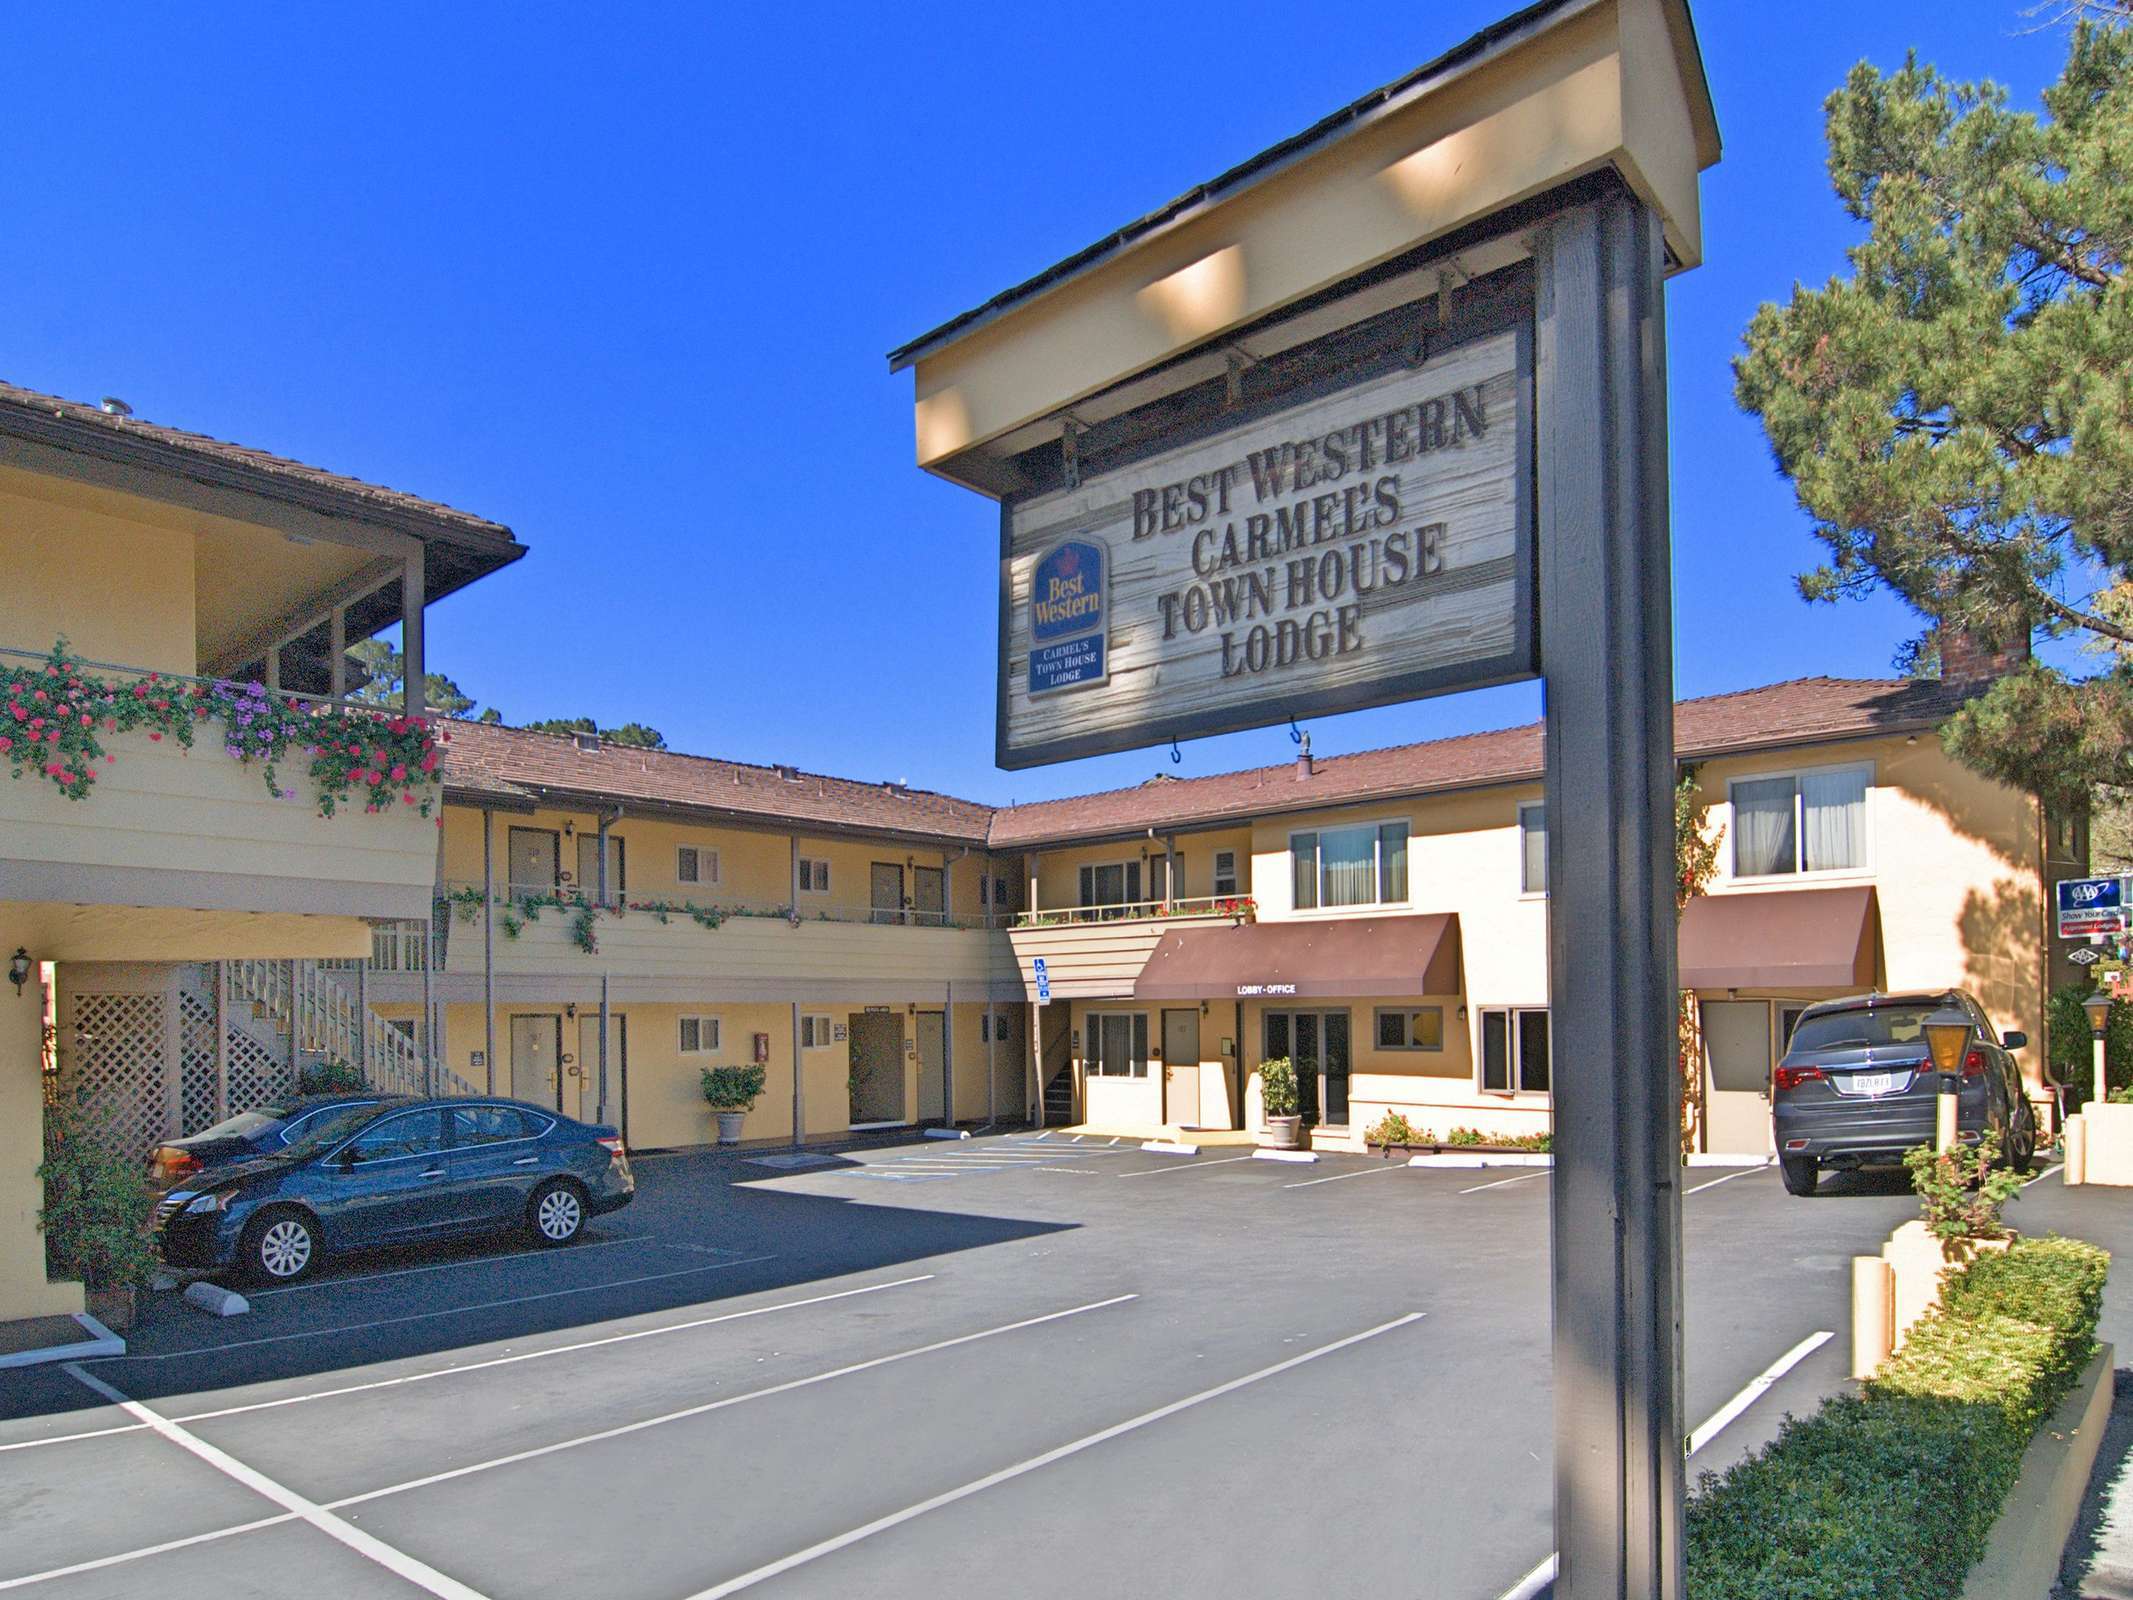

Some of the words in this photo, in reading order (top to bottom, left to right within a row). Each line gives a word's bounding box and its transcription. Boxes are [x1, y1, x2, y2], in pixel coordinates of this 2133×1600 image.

[1131, 466, 1238, 541] BEST
[1247, 385, 1487, 502] WESTERN
[1192, 474, 1401, 577] CARMEL'S
[1049, 572, 1084, 600] Best
[1158, 566, 1276, 640] TOWN
[1285, 522, 1447, 610] HOUSE
[1035, 592, 1099, 625] Western
[1043, 640, 1089, 661] CARMEL'S
[1221, 604, 1363, 678] LODGE
[1036, 660, 1062, 676] TOWN
[1064, 653, 1097, 669] HOUSE
[1050, 669, 1081, 687] LODGE
[2062, 912, 2082, 921] Show
[2085, 910, 2100, 918] Your
